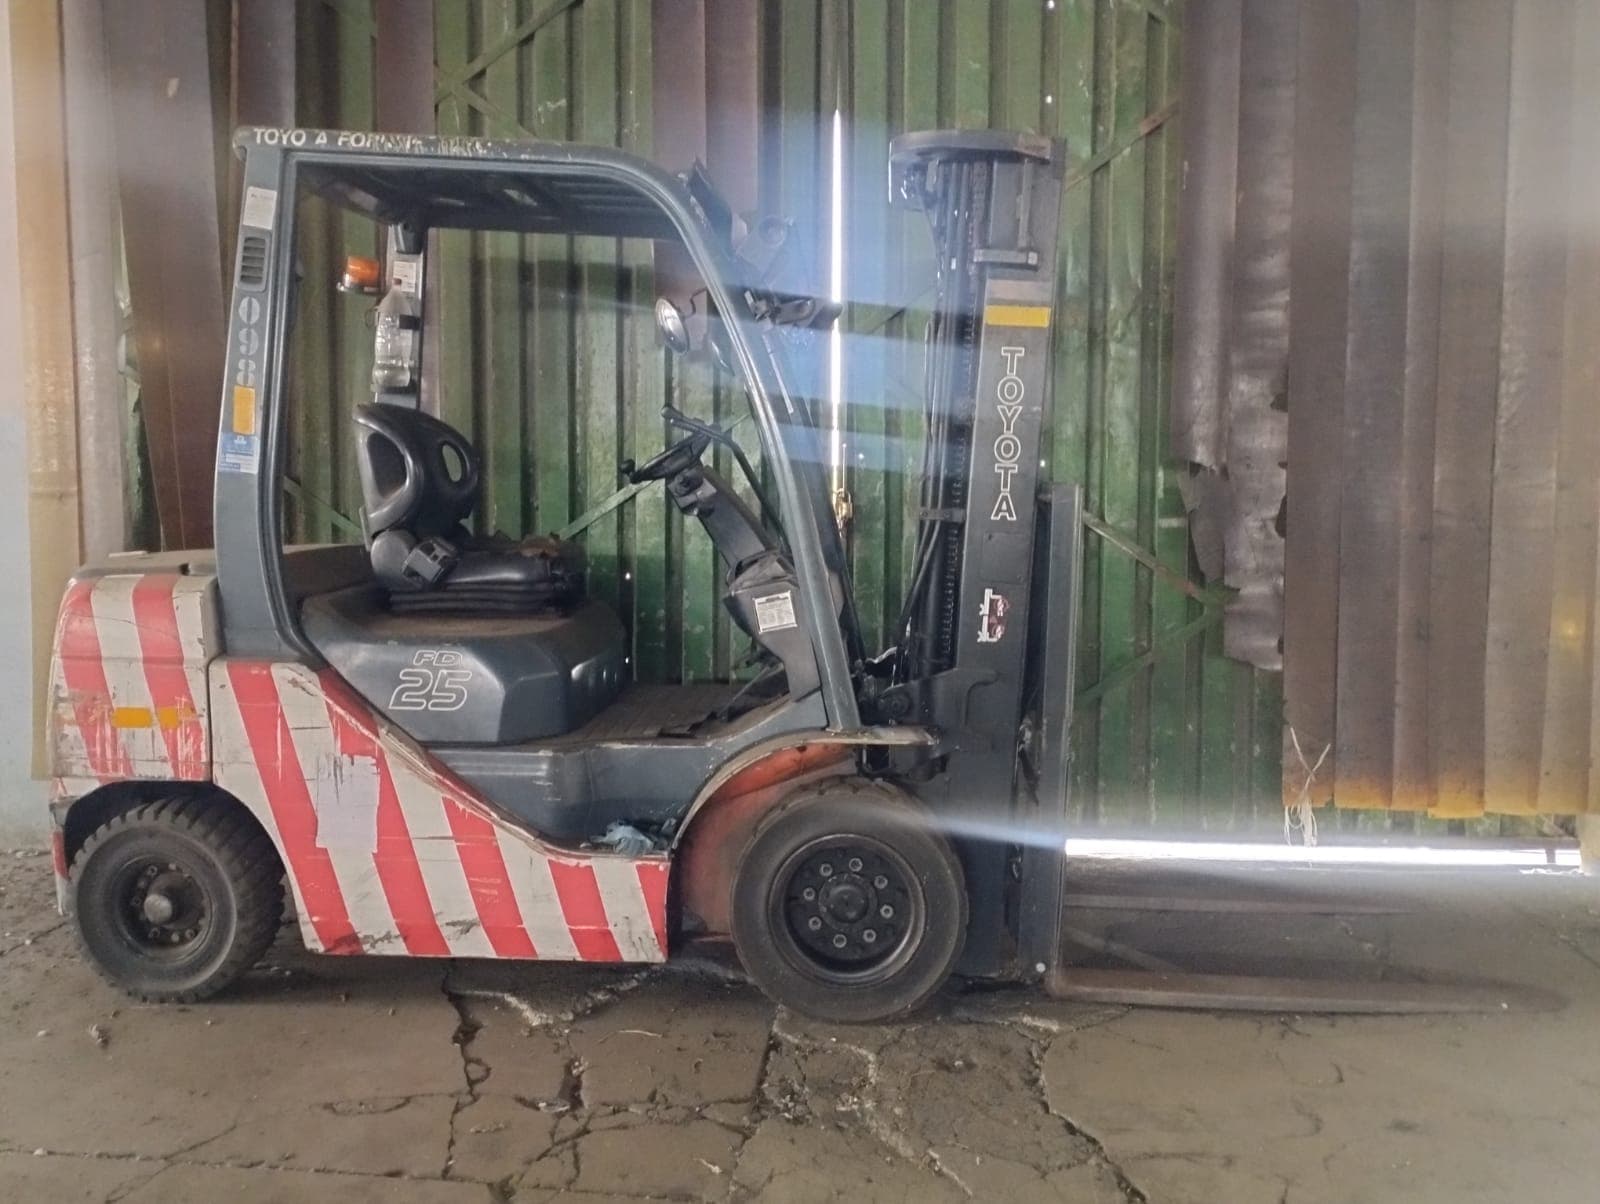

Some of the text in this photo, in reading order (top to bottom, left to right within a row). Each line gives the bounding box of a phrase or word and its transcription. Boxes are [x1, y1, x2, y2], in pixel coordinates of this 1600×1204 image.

[991, 346, 1025, 521] TOYOTA
[413, 650, 462, 667] FD
[388, 668, 472, 711] 25
